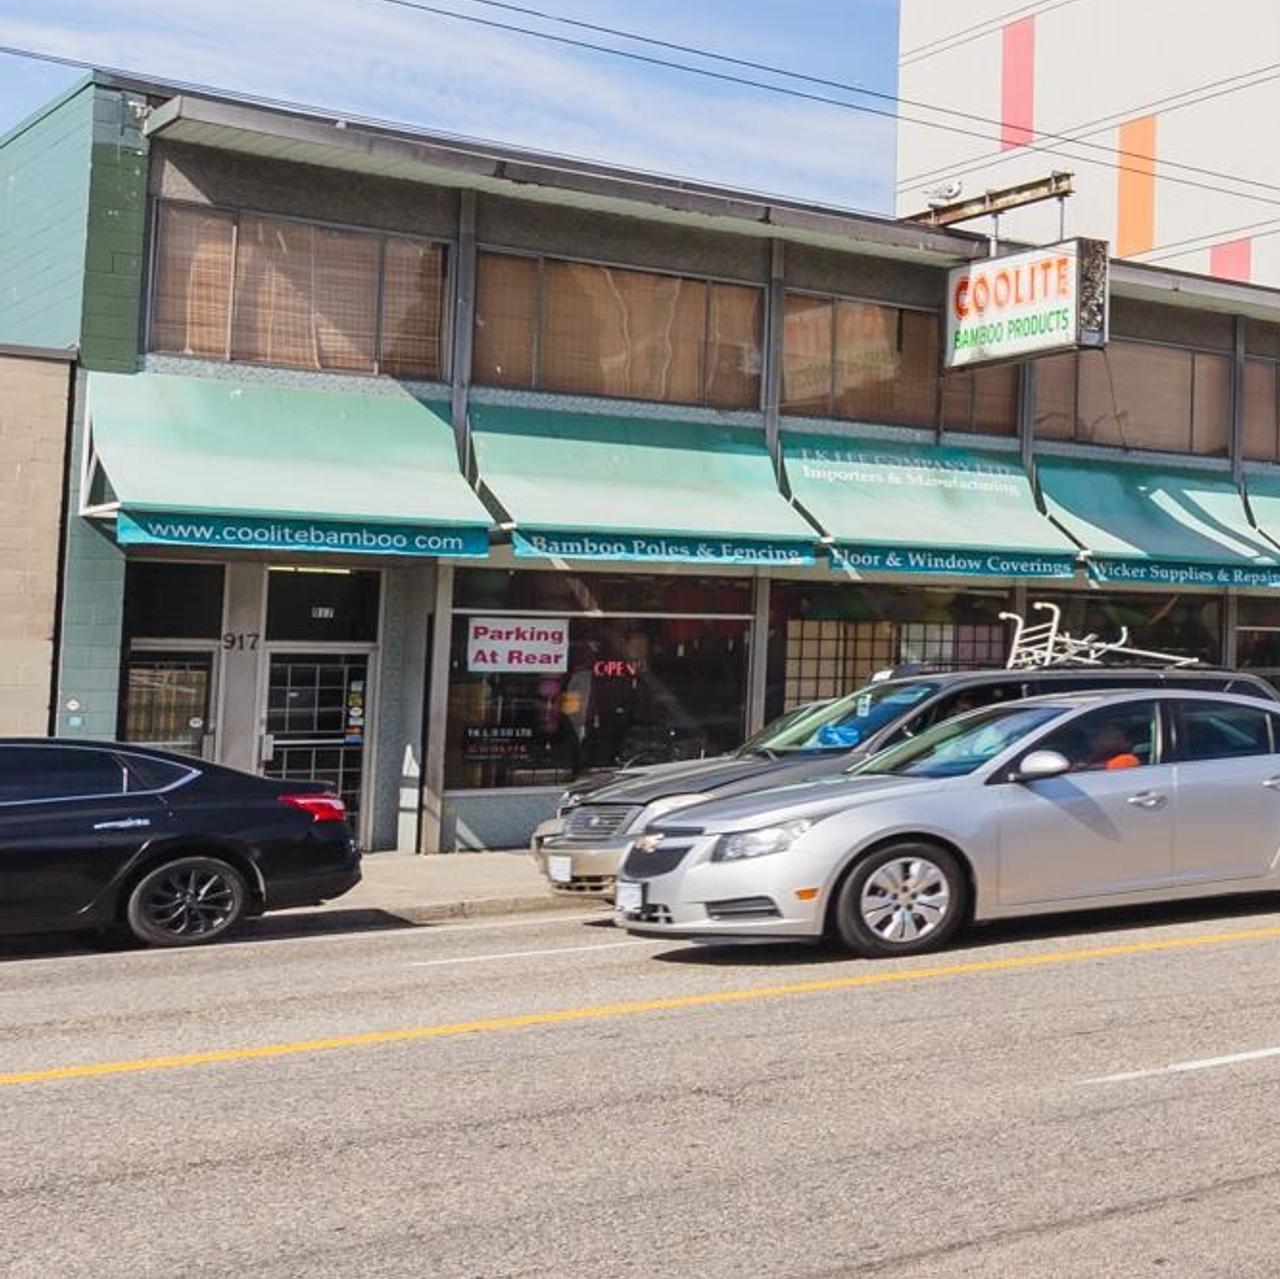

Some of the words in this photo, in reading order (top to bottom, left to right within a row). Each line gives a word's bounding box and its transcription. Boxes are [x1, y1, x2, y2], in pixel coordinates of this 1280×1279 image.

[954, 256, 1070, 320] COOLITE
[953, 323, 1004, 350] BAMBOO
[1008, 309, 1069, 338] PRODUCTS
[531, 536, 626, 555] Bamboo
[634, 539, 689, 557] Poles
[697, 543, 714, 558] &
[721, 545, 800, 561] Fencing
[833, 548, 880, 567] Floor
[885, 551, 903, 567] &
[907, 552, 983, 571] Window
[986, 555, 1072, 575] Coverings
[1093, 561, 1145, 579] Wicker
[1150, 565, 1214, 584] Supplies
[1217, 568, 1230, 582] &
[223, 632, 260, 651] 917
[473, 625, 564, 645] Parking
[473, 649, 499, 665] At
[506, 650, 564, 665] Rear
[594, 660, 638, 677] OPEN
